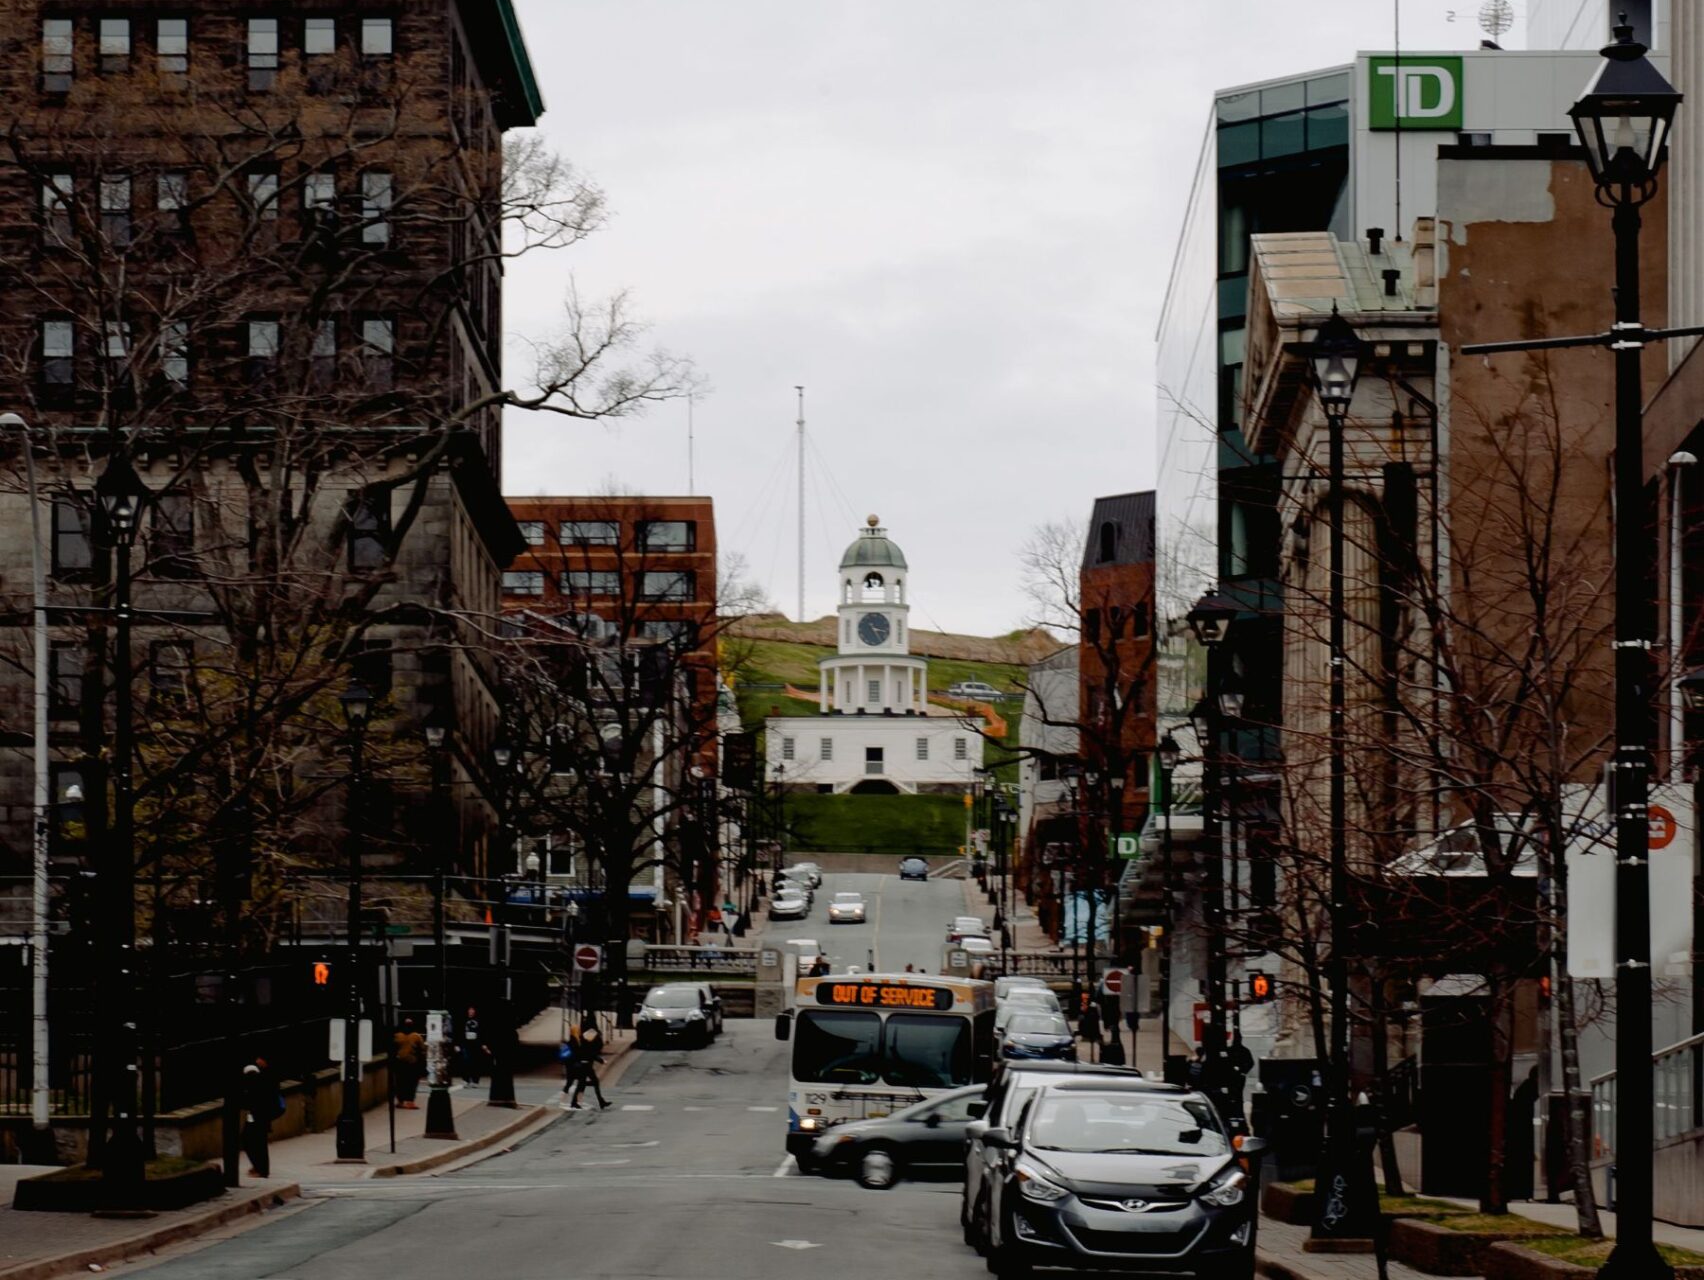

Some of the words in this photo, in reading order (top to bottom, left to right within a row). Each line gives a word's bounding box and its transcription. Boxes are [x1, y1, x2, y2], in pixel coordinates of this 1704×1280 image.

[1377, 66, 1455, 117] TD
[833, 985, 857, 1003] OUT
[861, 987, 877, 1004] OF
[880, 988, 936, 1007] SERVICE
